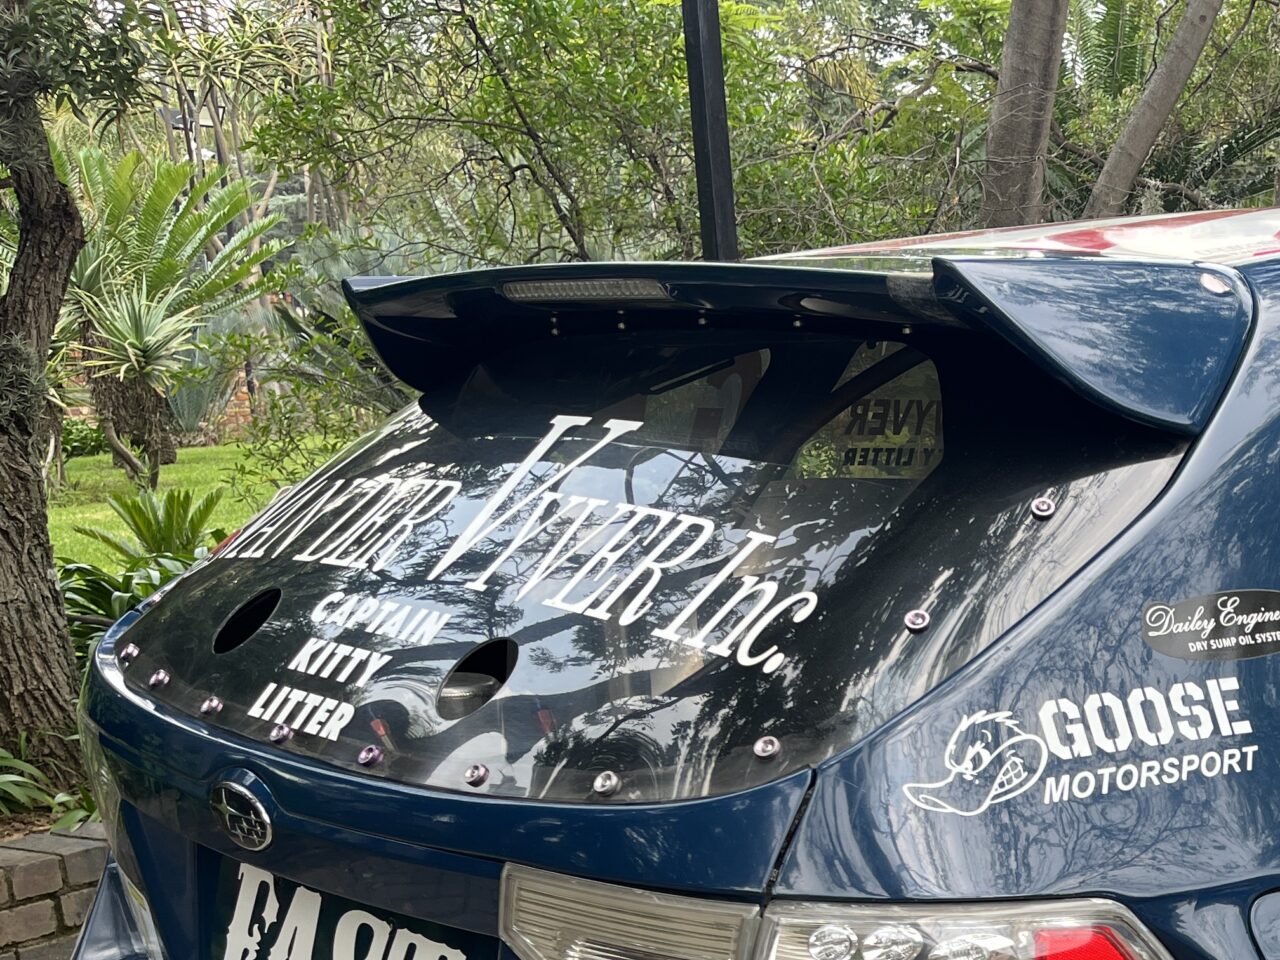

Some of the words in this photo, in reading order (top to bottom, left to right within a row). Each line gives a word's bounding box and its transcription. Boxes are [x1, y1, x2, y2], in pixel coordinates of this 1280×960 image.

[292, 476, 462, 572] DER
[310, 591, 452, 646] CAPTAIN
[1145, 604, 1216, 639] Dailey
[1188, 641, 1208, 653] DRY
[1210, 636, 1237, 650] SUMP
[1238, 635, 1254, 646] OIL
[287, 636, 393, 688] KITTY
[247, 682, 356, 742] LITTER
[1038, 675, 1253, 761] GOOSE
[1043, 744, 1259, 805] MOTORSPORT
